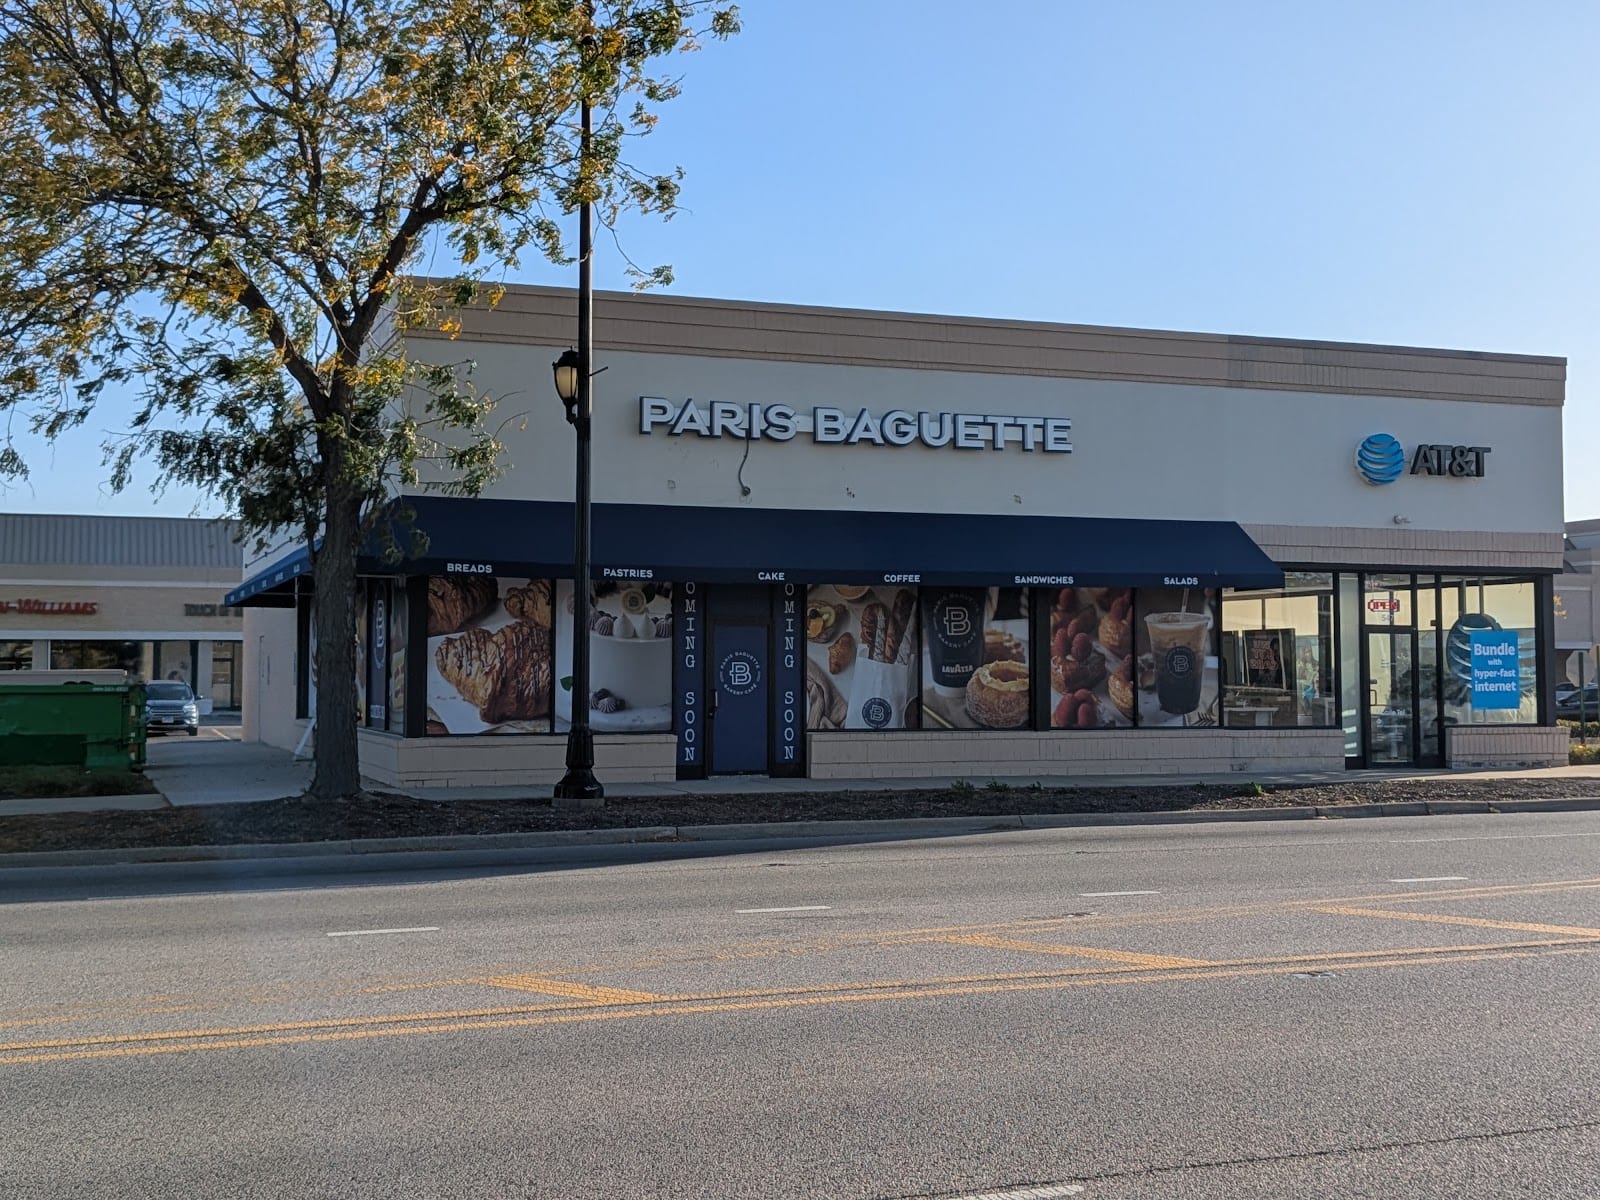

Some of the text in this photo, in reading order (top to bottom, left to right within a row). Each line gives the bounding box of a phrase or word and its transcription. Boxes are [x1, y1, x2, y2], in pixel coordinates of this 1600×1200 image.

[639, 396, 1072, 453] PARIS BAGUETTE
[1410, 444, 1492, 477] AT&T
[447, 563, 492, 574] BREADS
[603, 567, 653, 579] PASTRIES
[757, 571, 785, 582] CAKE
[883, 574, 921, 584] COFFEE
[1014, 575, 1074, 586] SANDWICHES
[1163, 576, 1199, 586] SALADS
[1367, 600, 1398, 611] OPEN
[1473, 643, 1516, 656] Bundle
[1487, 658, 1503, 666] with
[685, 581, 696, 761] OMING SOON
[784, 583, 795, 760] OMING SOON
[1474, 669, 1516, 680] hyper-fast
[1474, 681, 1517, 692] internet
